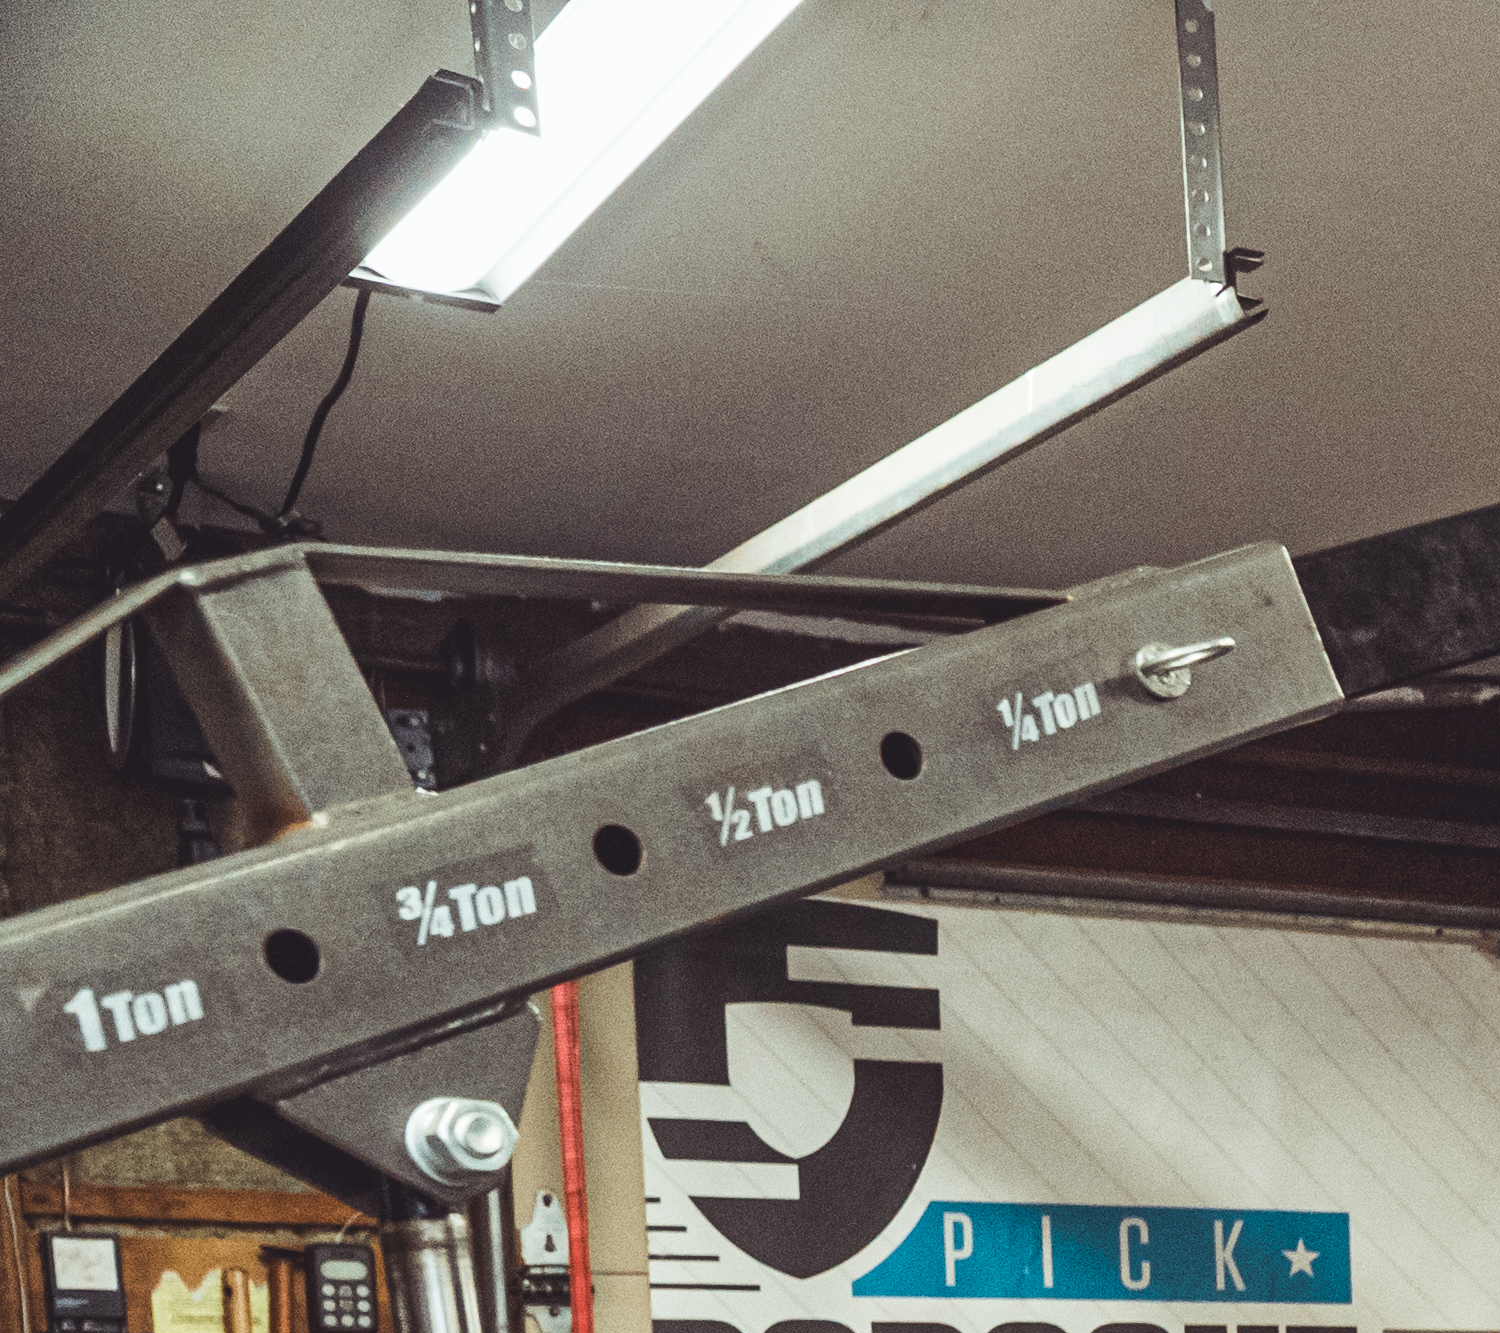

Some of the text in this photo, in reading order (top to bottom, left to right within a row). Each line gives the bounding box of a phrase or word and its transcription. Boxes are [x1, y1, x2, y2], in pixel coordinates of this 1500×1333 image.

[1032, 682, 1101, 735] Ton
[747, 779, 825, 832] Ton
[447, 876, 538, 932] Ton
[63, 979, 204, 1051] 1 Ton
[943, 1211, 1246, 1291] PICK
